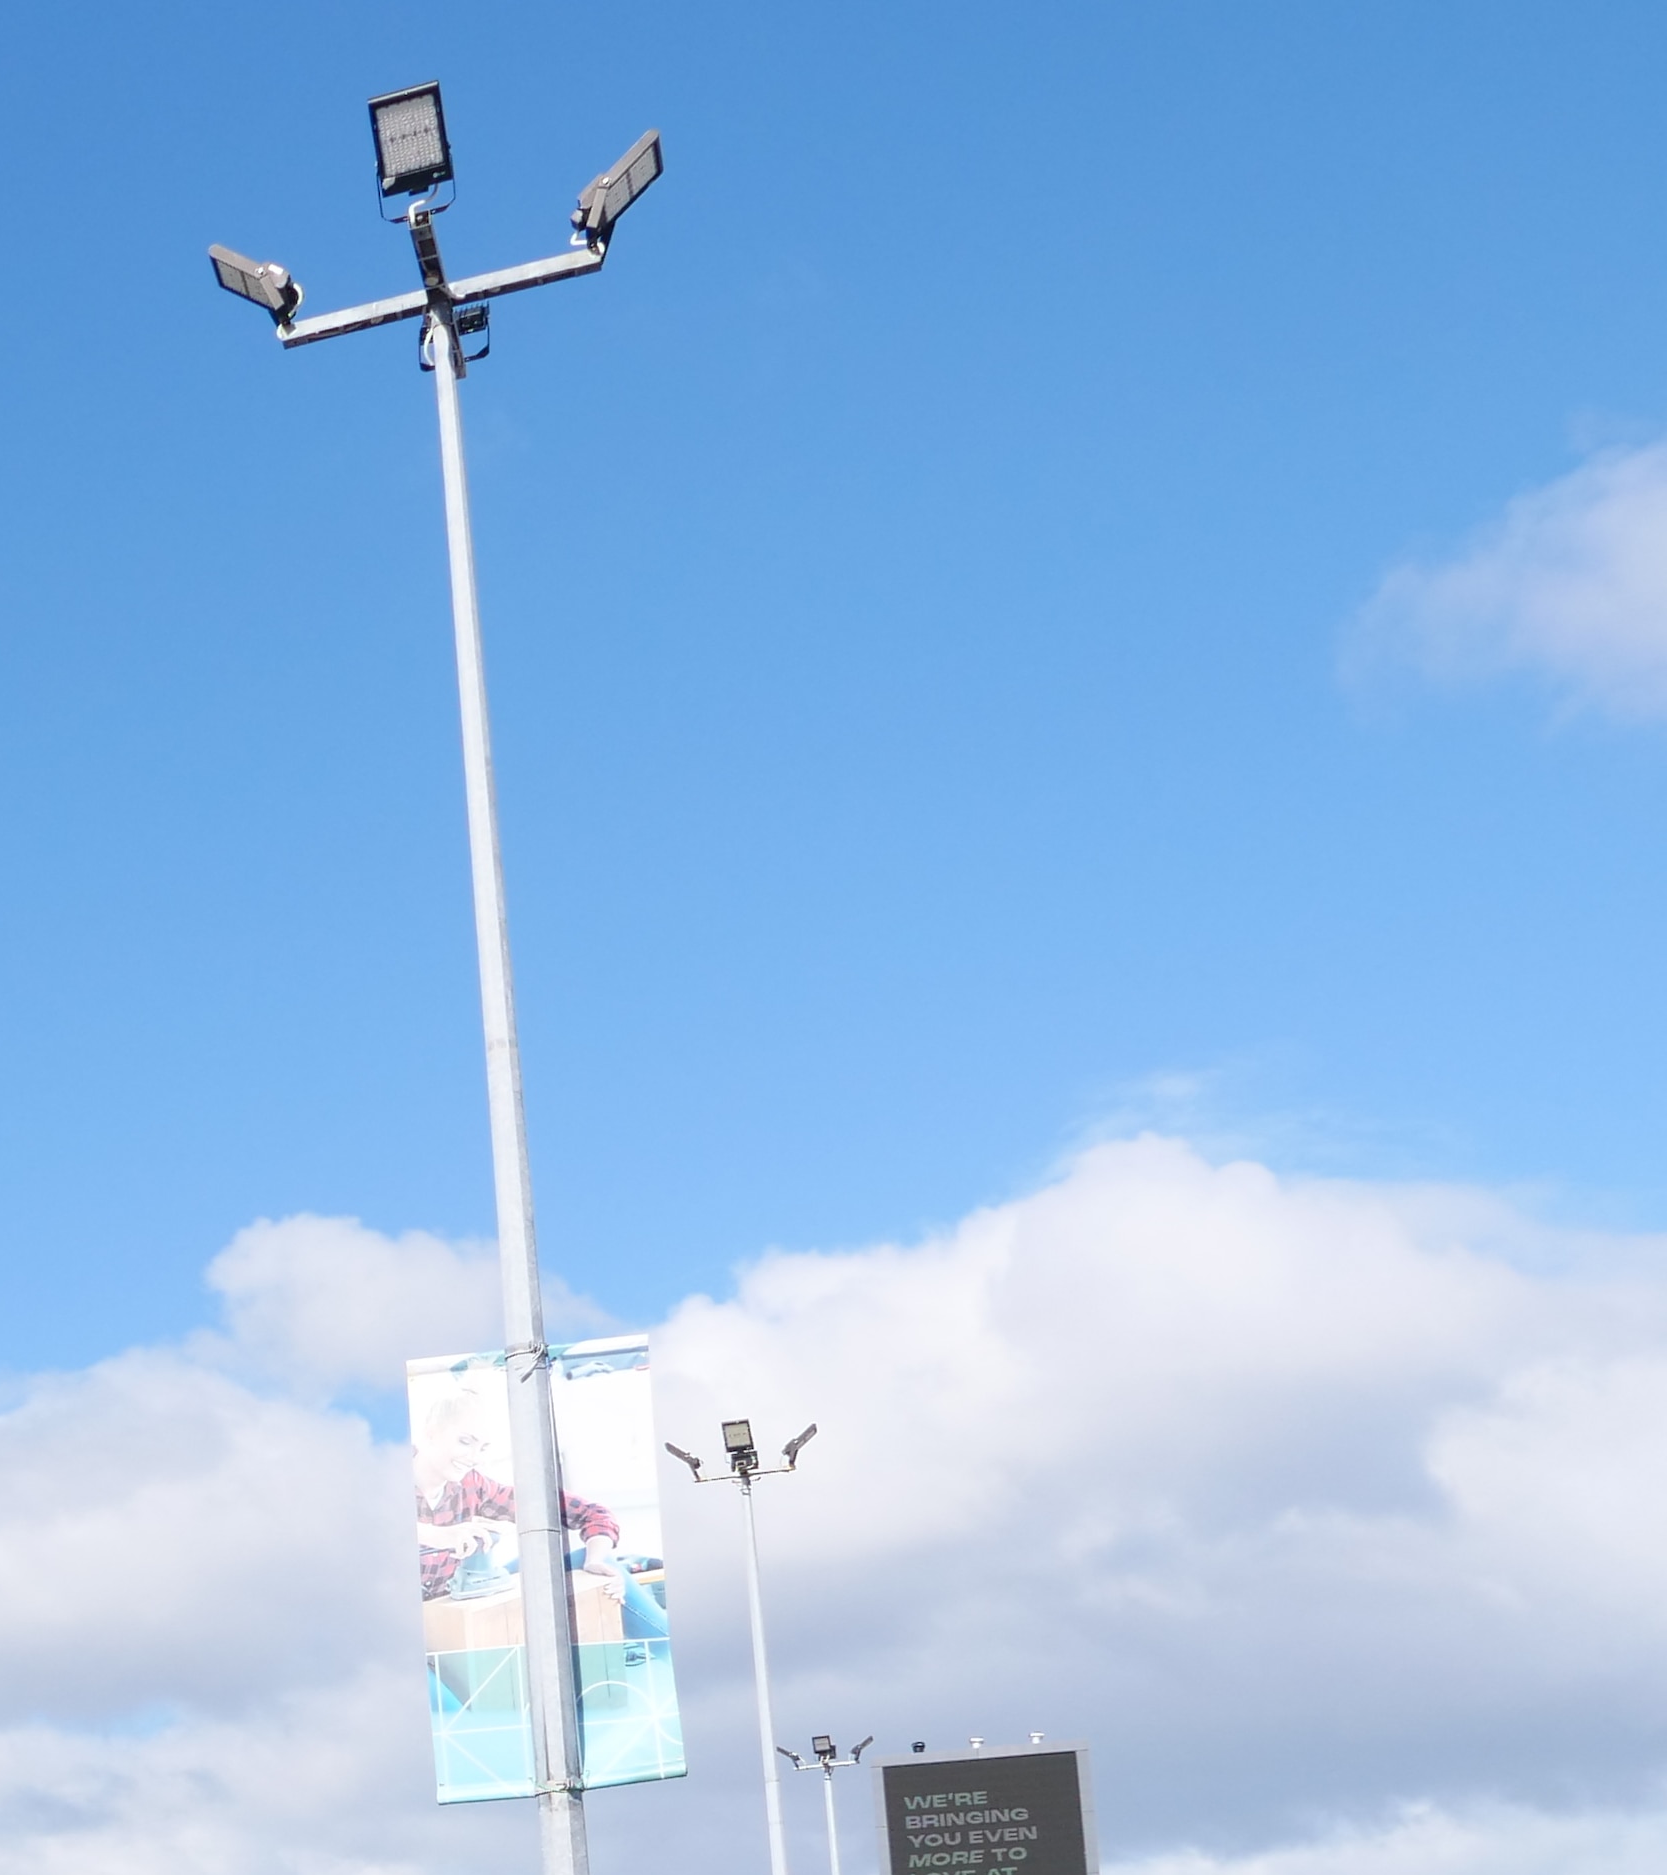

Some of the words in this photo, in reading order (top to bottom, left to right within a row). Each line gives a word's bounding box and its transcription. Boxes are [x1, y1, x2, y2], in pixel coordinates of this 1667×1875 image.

[904, 1791, 987, 1810] WE'RE
[905, 1808, 1029, 1830] BRINGING
[907, 1833, 960, 1848] YOU
[969, 1826, 1037, 1844] EVEN
[908, 1850, 984, 1868] MORE
[991, 1847, 1027, 1862] TO
